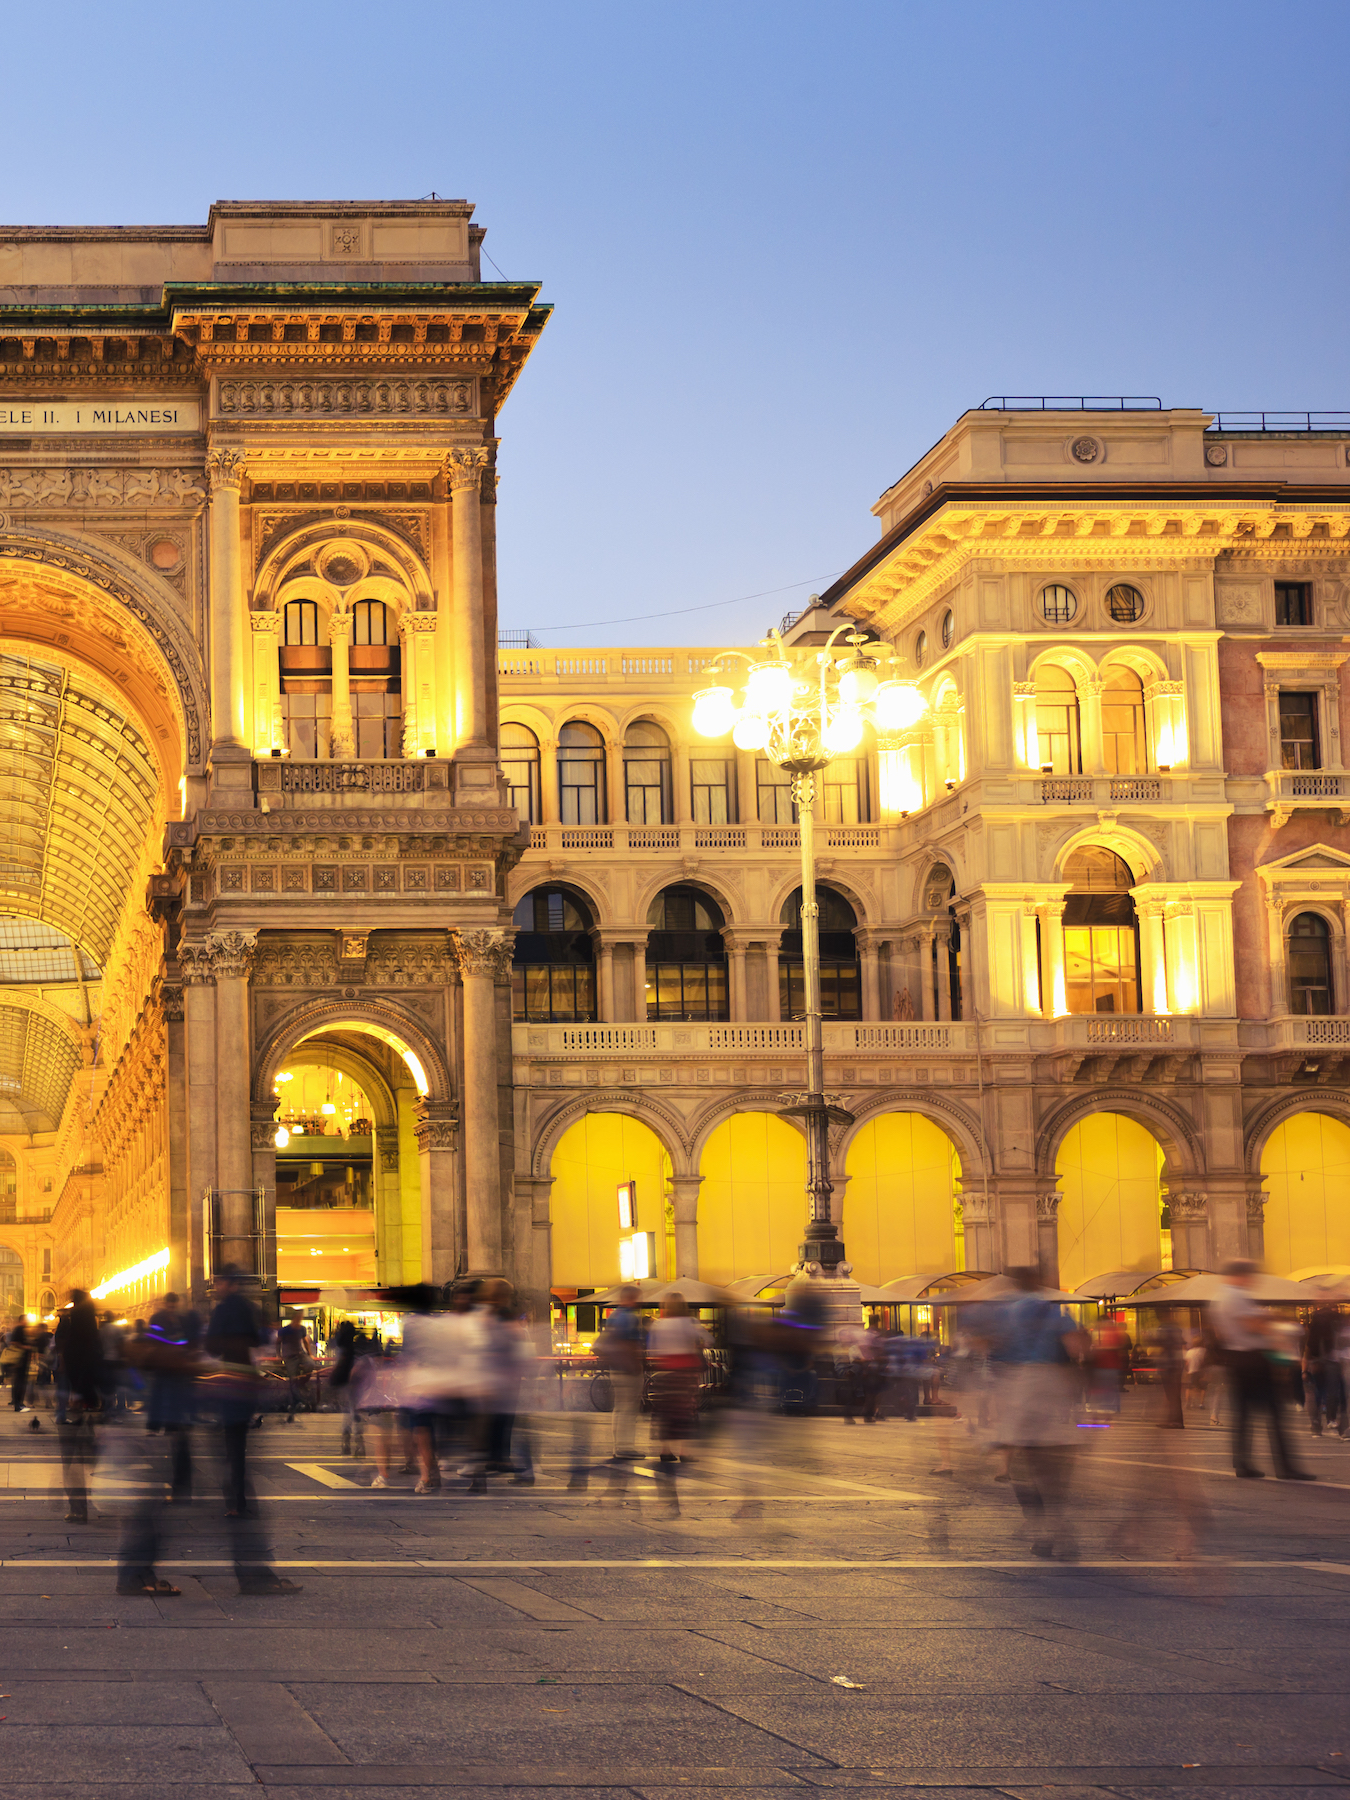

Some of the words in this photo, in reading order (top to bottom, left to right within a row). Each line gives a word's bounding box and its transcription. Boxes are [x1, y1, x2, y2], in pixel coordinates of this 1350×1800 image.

[44, 410, 60, 424] II.
[76, 410, 81, 424] I
[93, 410, 178, 424] MILANESI
